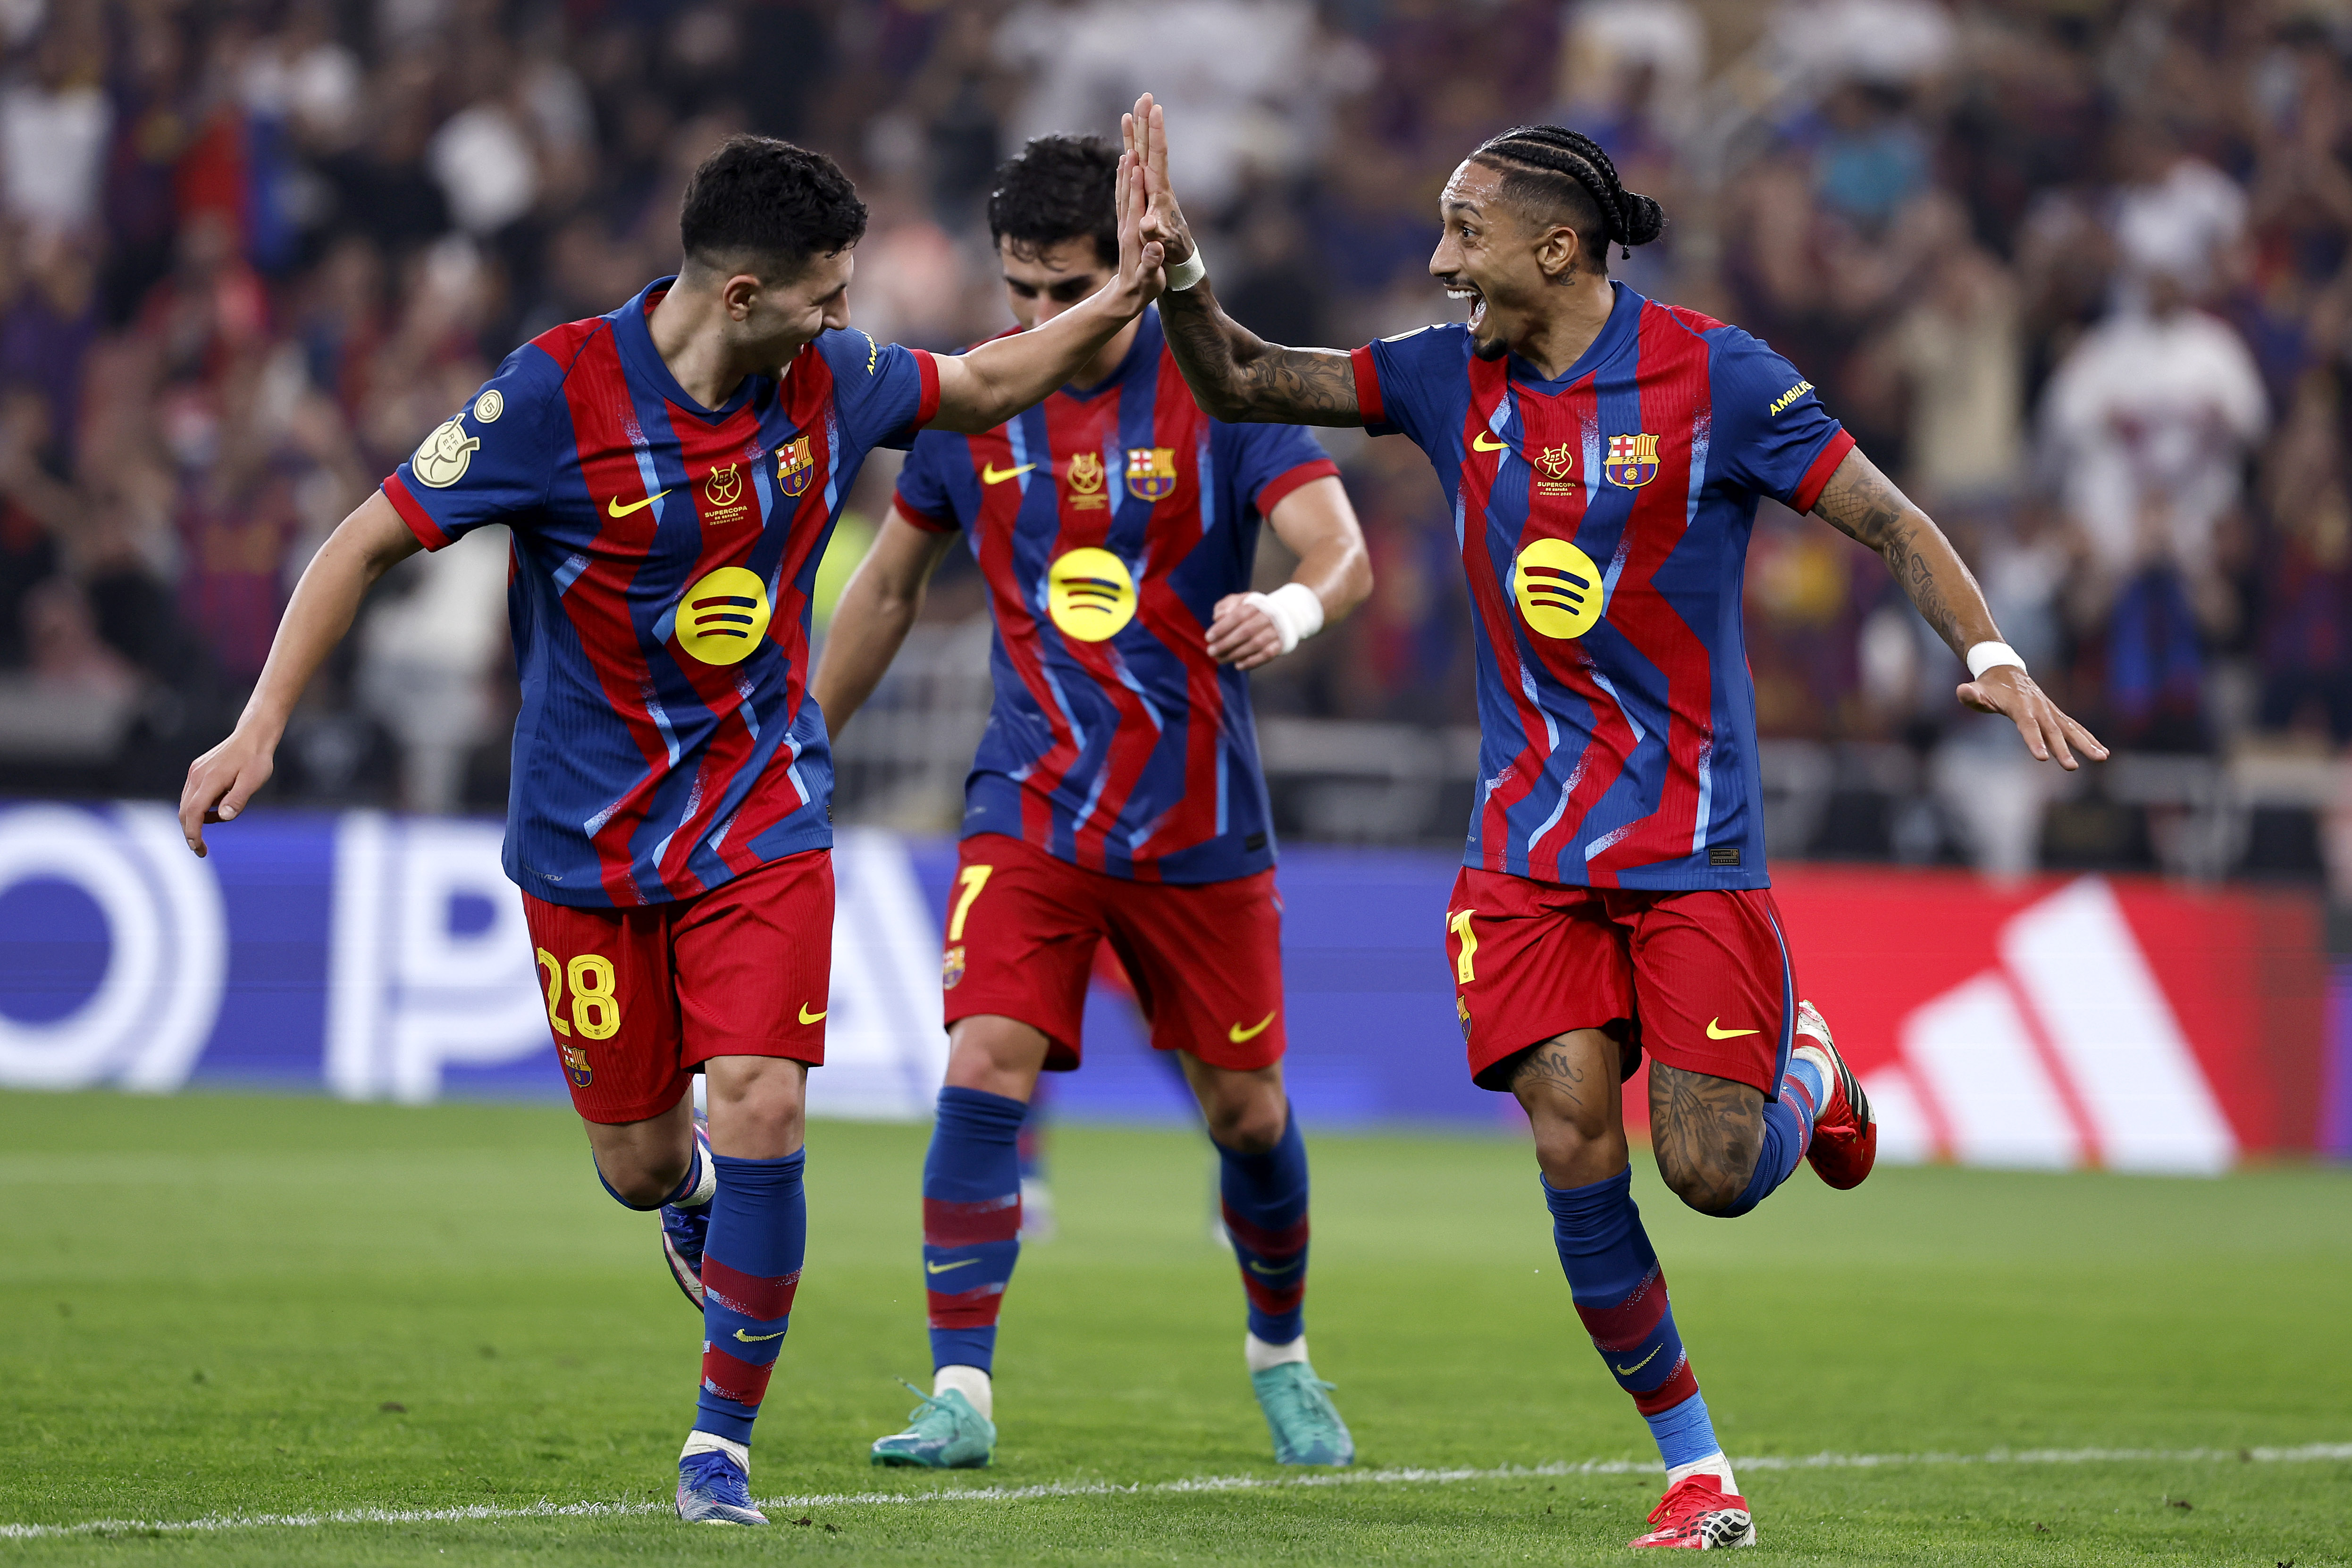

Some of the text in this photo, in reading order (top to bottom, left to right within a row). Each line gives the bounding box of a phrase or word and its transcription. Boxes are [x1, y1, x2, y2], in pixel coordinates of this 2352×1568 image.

[483, 398, 495, 413] 15
[789, 461, 804, 474] FCB
[705, 506, 748, 518] SUPERCOPA
[949, 864, 993, 941] 7
[1446, 909, 1478, 985] 1
[537, 947, 621, 1040] 28
